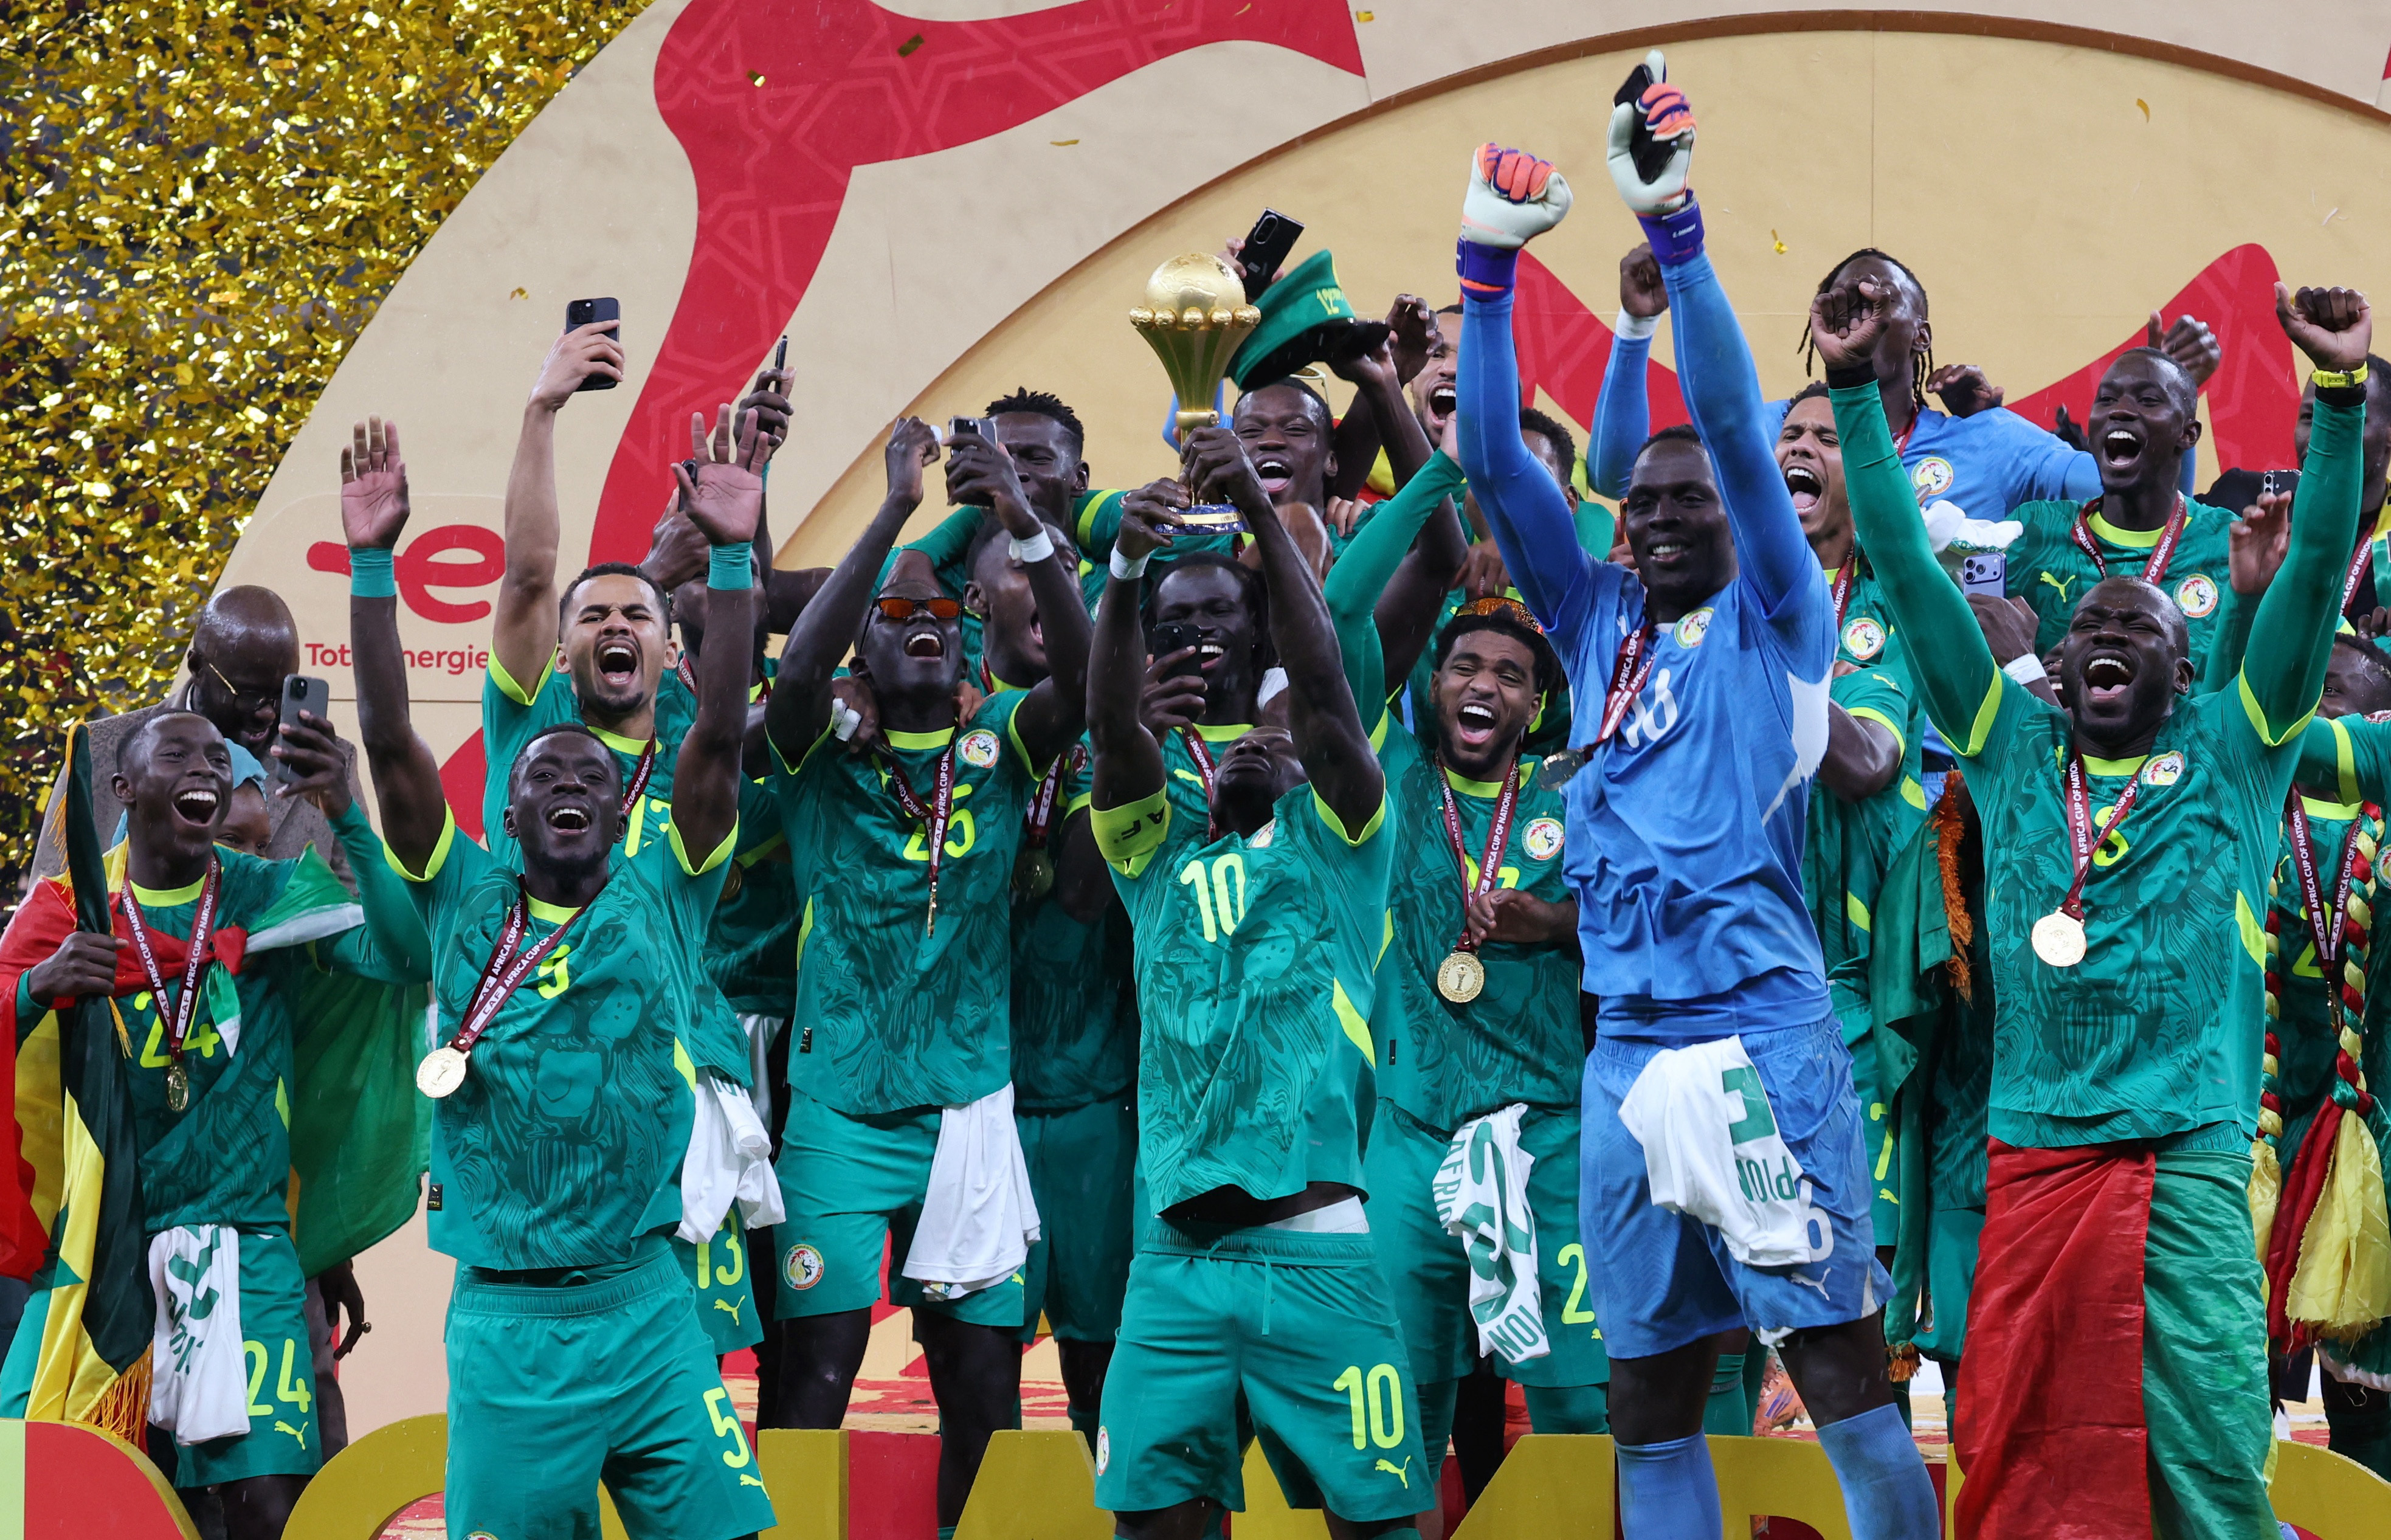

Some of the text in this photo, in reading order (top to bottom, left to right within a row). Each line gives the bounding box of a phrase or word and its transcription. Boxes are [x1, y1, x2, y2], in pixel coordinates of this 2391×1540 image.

[2075, 524, 2097, 556] NATIONS
[2148, 564, 2159, 578] OF
[2155, 536, 2172, 567] NATIONS
[2345, 575, 2356, 591] CUP
[2351, 564, 2361, 576] OF
[305, 643, 489, 675] Totnergie
[1617, 637, 1638, 691] AFRICA CUP
[637, 754, 651, 784] NATIONS
[940, 772, 948, 787] CUP
[938, 787, 948, 817] AFRICA
[2072, 789, 2083, 802] OF
[2074, 801, 2084, 820] CUP
[2114, 797, 2127, 812] CUP
[2124, 787, 2136, 798] OF
[1485, 762, 1519, 879] AFRICA CUP OF NATIONS MOROCC
[2075, 820, 2089, 854] AFRICA
[2343, 861, 2353, 879] CUP
[2347, 849, 2356, 862] OF
[2292, 810, 2325, 942] CAF AFRICA CUP OF NATIONS
[1179, 852, 1246, 942] 10
[2336, 879, 2350, 910] AFRICA
[123, 897, 142, 930] NATIONS
[198, 893, 213, 929] NATIONS
[135, 928, 145, 942] OF
[196, 927, 207, 941] OF
[2331, 916, 2340, 943] CAF
[139, 942, 154, 961] CUP
[192, 941, 202, 958] CUP
[491, 944, 512, 976] AFRICA
[506, 926, 519, 945] CUP
[146, 958, 162, 989] AFRICA
[185, 958, 199, 989] AFRICA
[483, 990, 502, 1016] CAF
[504, 959, 530, 987] AFRICA
[525, 944, 541, 962] CUP
[179, 996, 190, 1021] CAF
[134, 990, 220, 1068] 24
[244, 1338, 312, 1420] 24
[1333, 1362, 1404, 1450] 10
[703, 1387, 750, 1468] 5
